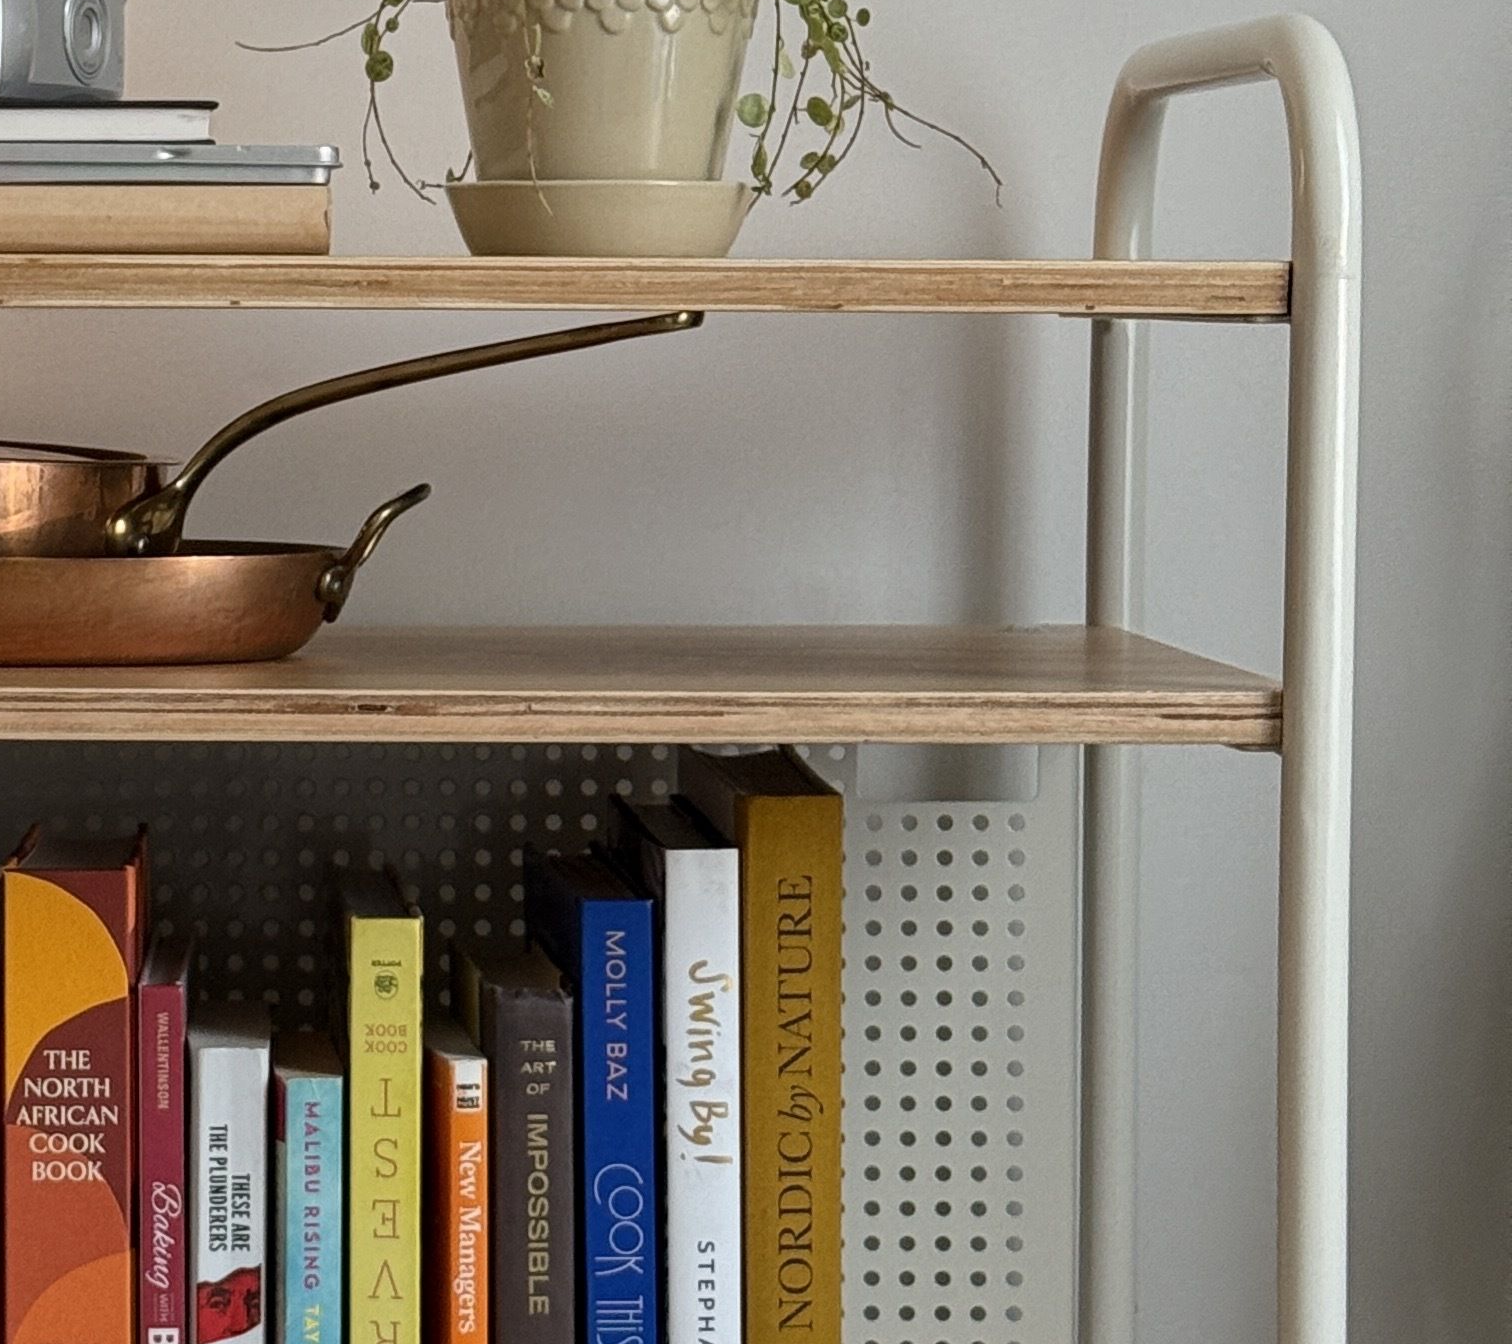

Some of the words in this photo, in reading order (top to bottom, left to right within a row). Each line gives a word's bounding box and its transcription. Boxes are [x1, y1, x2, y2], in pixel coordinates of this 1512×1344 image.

[605, 931, 626, 1030] MOLLY
[777, 874, 813, 1078] NATURE
[365, 1024, 407, 1037] BOOK
[676, 959, 732, 1087] Swing
[43, 1049, 91, 1070] THE
[365, 1040, 407, 1053] COOK
[521, 1040, 555, 1052] THE
[24, 1077, 110, 1098] NORTH
[521, 1061, 556, 1074] ART
[606, 1043, 628, 1100] BAZ
[526, 1083, 550, 1095] OF
[777, 1086, 823, 1122] by
[16, 1105, 119, 1126] AFRICAN
[677, 1100, 733, 1164] By!
[29, 1133, 106, 1154] COOK
[209, 1124, 227, 1152] THE
[304, 1102, 321, 1194] MALIBU
[31, 1161, 106, 1182] BOOK
[459, 1140, 482, 1200] New
[209, 1157, 227, 1252] PLUNDERERS
[232, 1174, 250, 1215] THESE
[527, 1113, 550, 1315] IMPOSSIBLE
[145, 1180, 182, 1289] Baking
[231, 1219, 250, 1252] ARE
[303, 1207, 321, 1290] RISING
[777, 1132, 813, 1331] NORDIC
[452, 1207, 482, 1335] Managers
